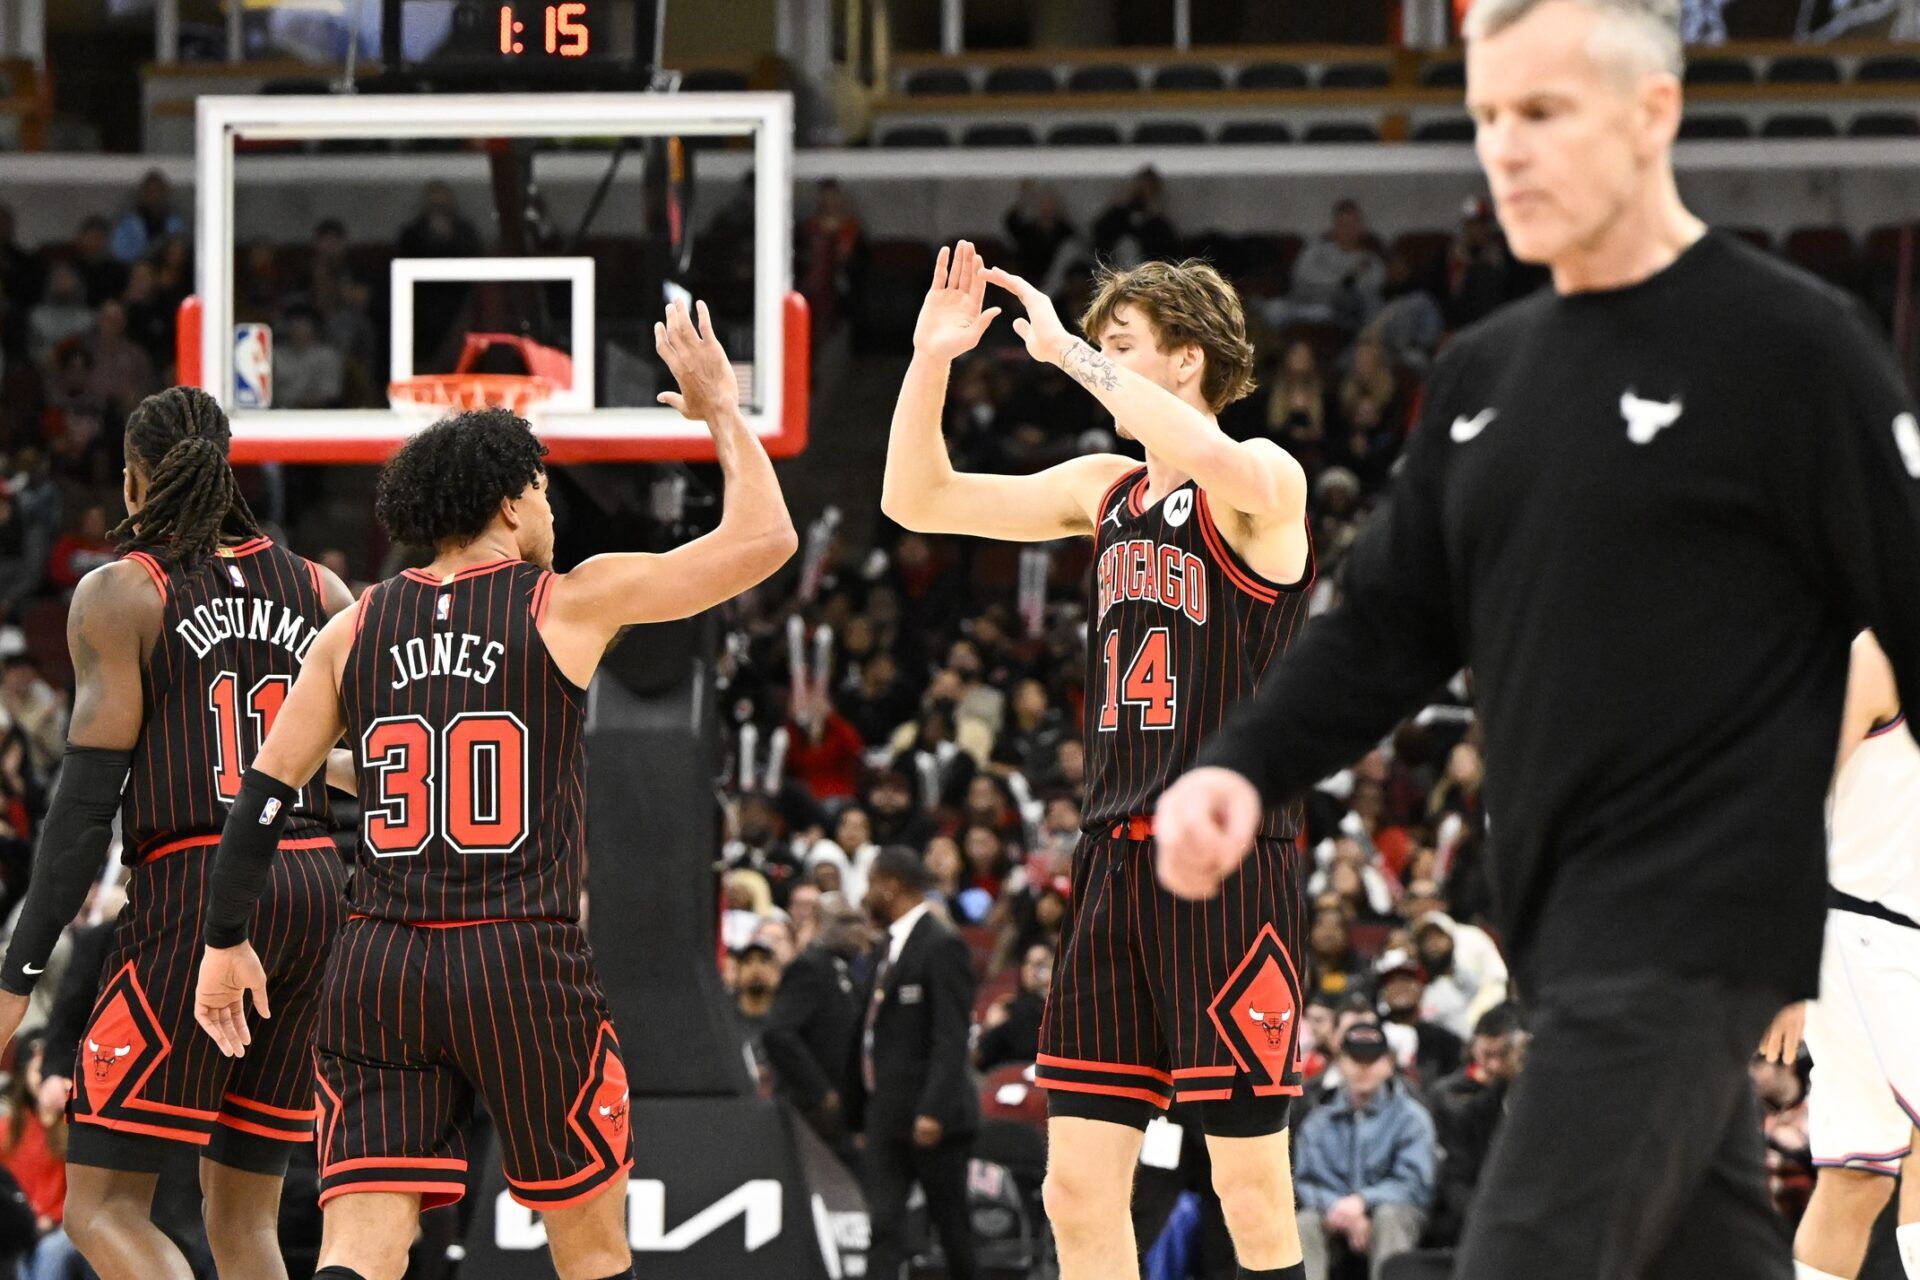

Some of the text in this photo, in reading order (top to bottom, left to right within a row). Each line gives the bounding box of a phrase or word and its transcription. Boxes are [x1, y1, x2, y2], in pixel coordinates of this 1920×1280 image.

[500, 3, 588, 56] 1:15
[389, 631, 505, 690] JONES
[1098, 626, 1177, 732] 14
[361, 711, 530, 858] 30
